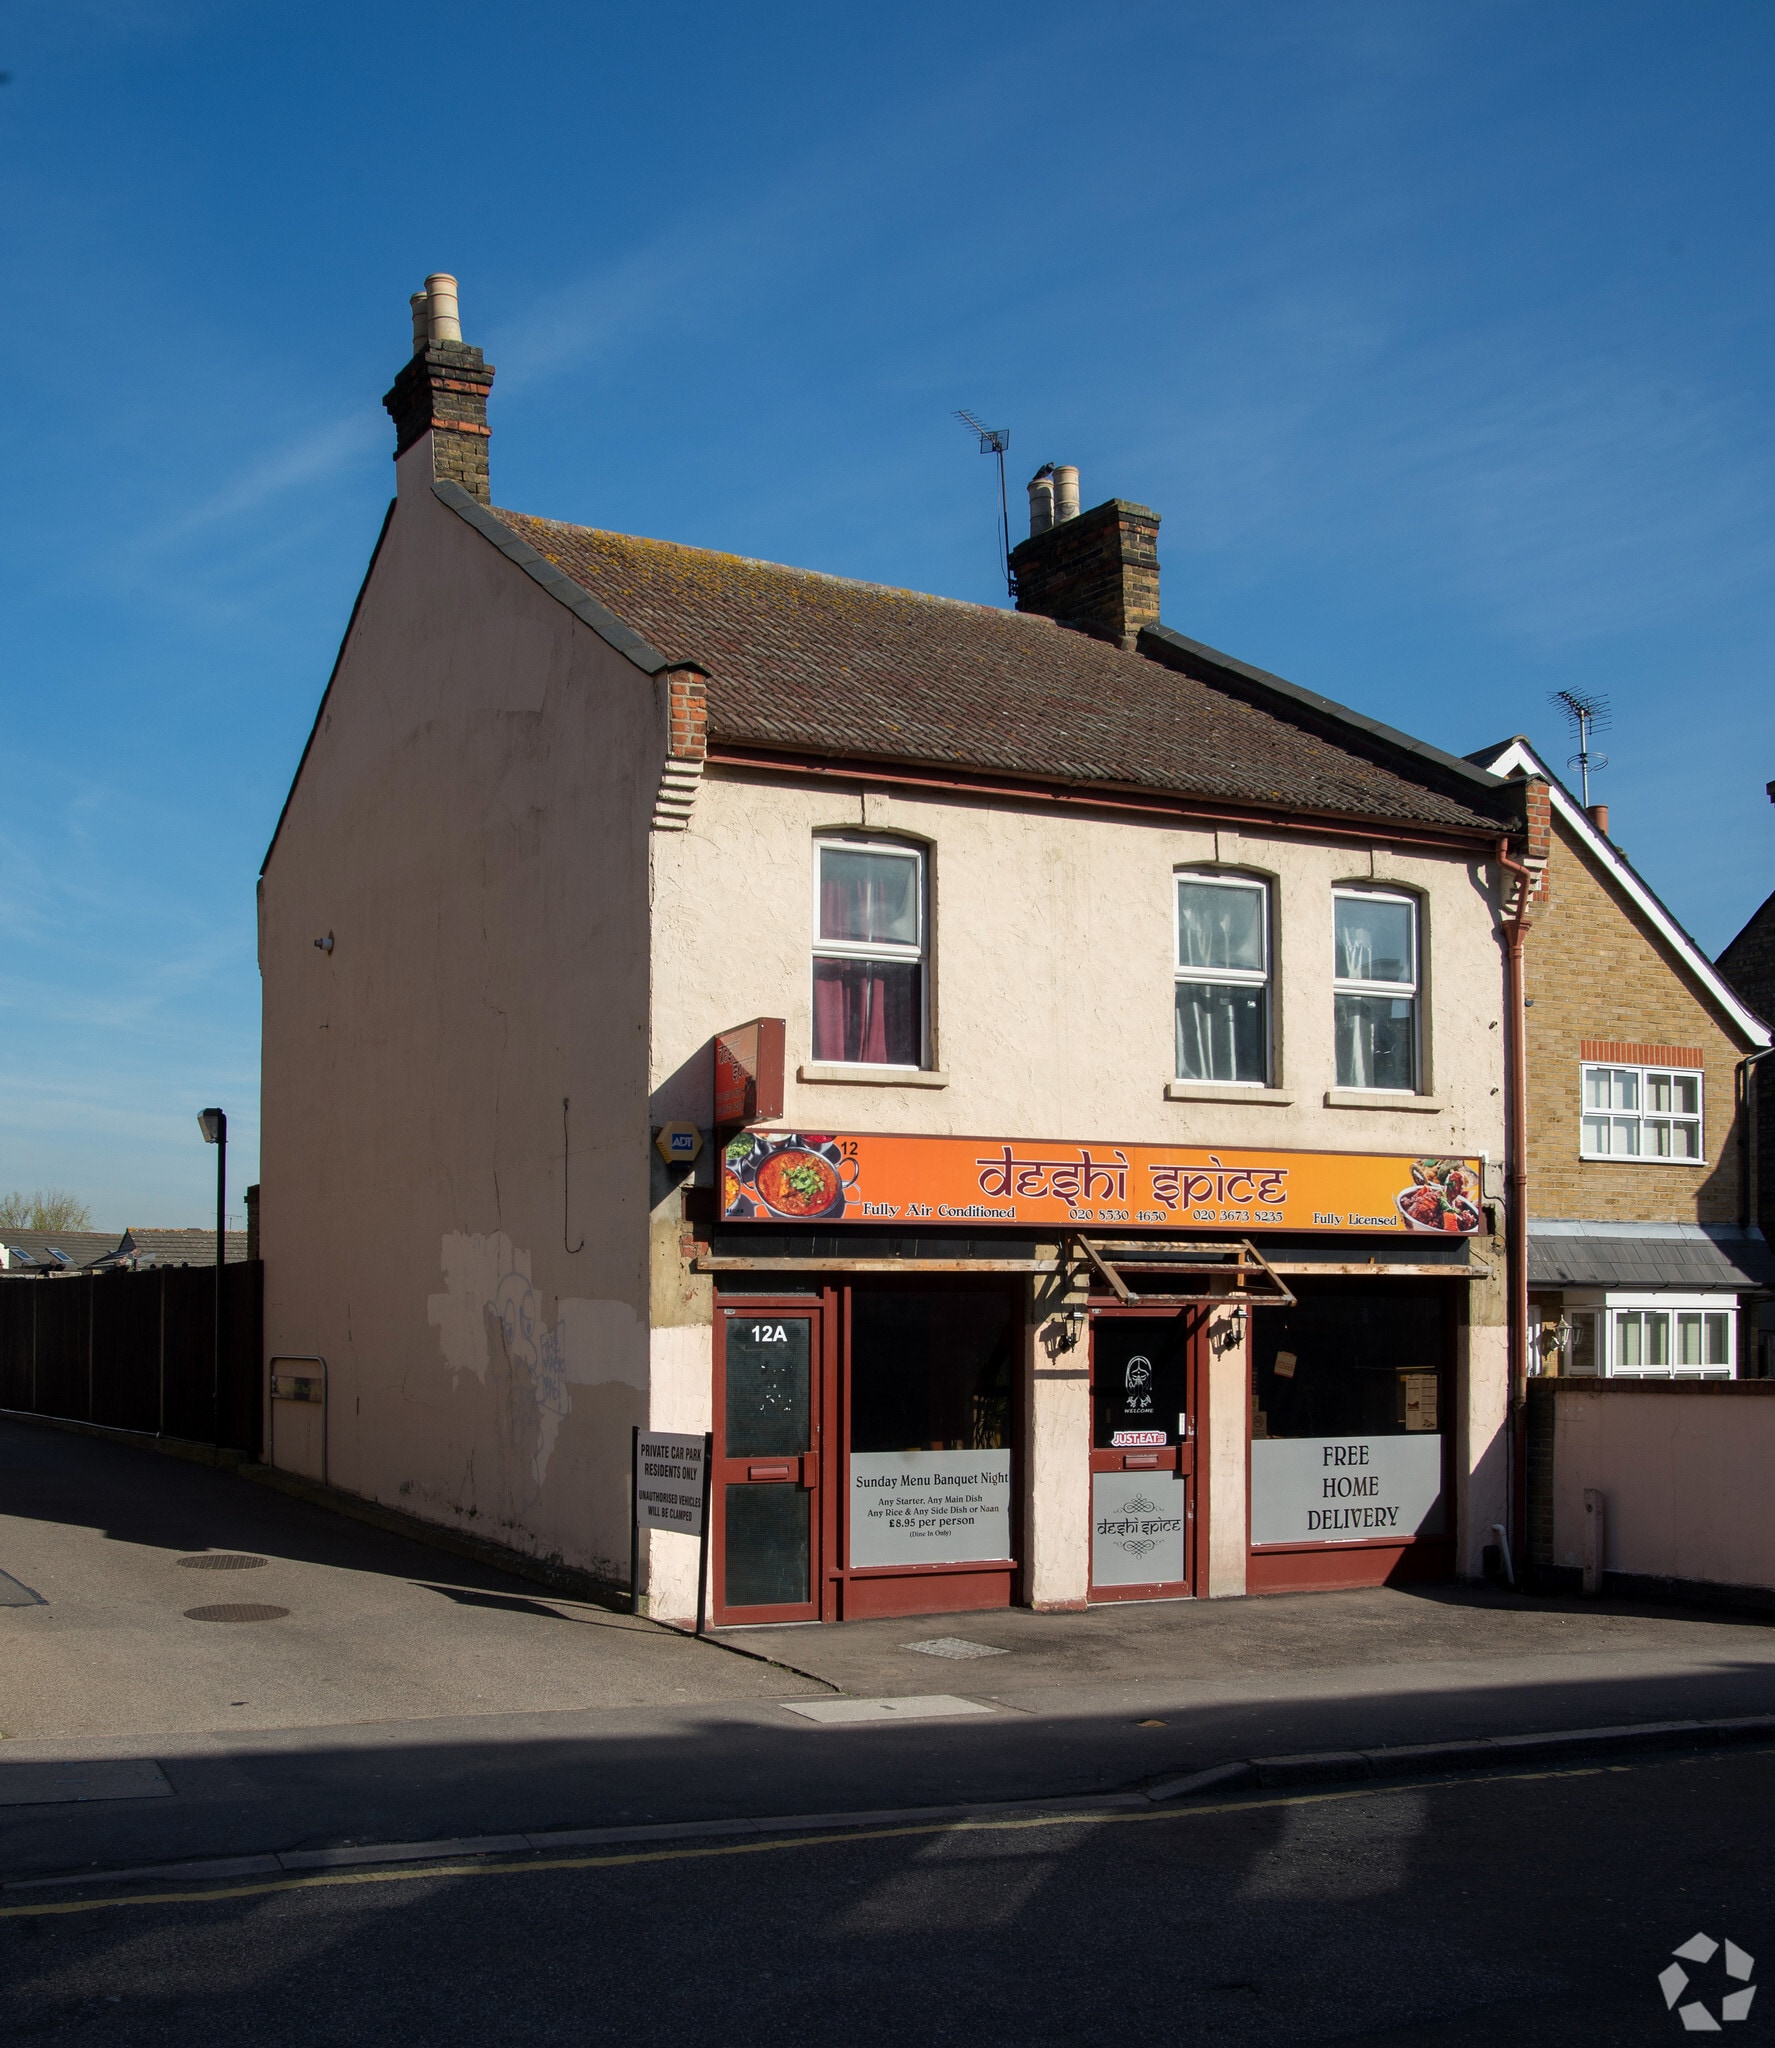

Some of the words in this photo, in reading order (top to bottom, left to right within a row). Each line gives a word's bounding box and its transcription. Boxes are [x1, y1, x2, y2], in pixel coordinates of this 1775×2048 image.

[672, 1136, 693, 1147] ADT
[841, 1141, 858, 1155] 12
[976, 1145, 1130, 1207] deshi
[1148, 1155, 1289, 1210] spice
[862, 1202, 900, 1218] Fully
[905, 1203, 933, 1217] Air
[938, 1204, 1016, 1219] Conditioned
[1069, 1208, 1094, 1220] 020
[1098, 1209, 1129, 1221] 8530
[1135, 1210, 1167, 1221] 4650
[1192, 1210, 1216, 1221] 020
[1219, 1210, 1250, 1222] 3673
[1254, 1211, 1283, 1222] 8235
[1313, 1212, 1343, 1225] Fully
[1348, 1213, 1397, 1226] Licensed
[751, 1325, 788, 1342] 12A
[1114, 1433, 1138, 1444] JUST
[1140, 1433, 1158, 1443] EAT
[640, 1444, 669, 1459] PRIVATE
[671, 1446, 685, 1460] CAR
[686, 1448, 702, 1461] PARK
[1323, 1445, 1370, 1466] FREE
[644, 1463, 681, 1479] RESIDENTS
[682, 1466, 698, 1480] ONLY
[856, 1475, 897, 1489] Sunday
[900, 1474, 931, 1487] Menu
[934, 1473, 978, 1487] Banquet
[981, 1472, 1009, 1486] Night
[1322, 1476, 1380, 1498] HOME
[639, 1490, 678, 1505] UNAUTHORISED
[679, 1495, 702, 1508] VEHICLES
[878, 1498, 894, 1507] Any
[927, 1497, 943, 1505] Any
[965, 1494, 983, 1502] Dish
[648, 1505, 661, 1517] WILL
[662, 1507, 669, 1518] BE
[670, 1508, 693, 1522] CLAMPED
[867, 1509, 883, 1518] Any
[885, 1508, 903, 1516] Rice
[905, 1508, 911, 1516] &
[913, 1508, 929, 1517] Any
[931, 1506, 948, 1515] Side
[950, 1505, 968, 1513] Dish
[1307, 1506, 1399, 1531] DELIVERY
[889, 1518, 916, 1528] £8.95
[918, 1518, 936, 1529] per
[939, 1517, 975, 1528] person
[1097, 1517, 1139, 1537] deshi
[1140, 1516, 1181, 1536] spice
[935, 1529, 952, 1537] Only)
